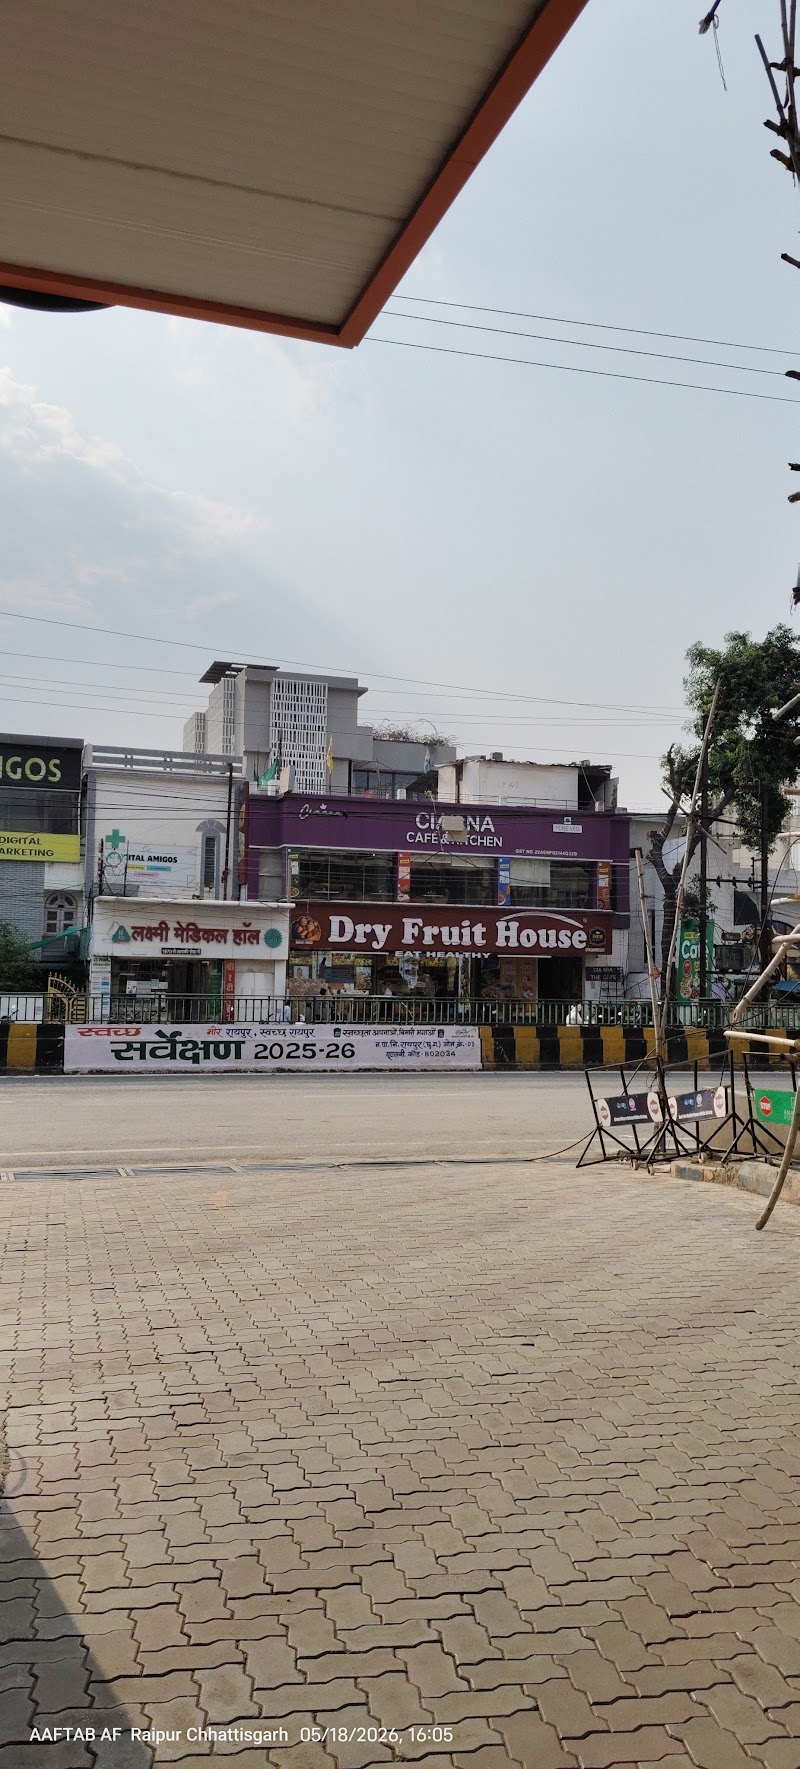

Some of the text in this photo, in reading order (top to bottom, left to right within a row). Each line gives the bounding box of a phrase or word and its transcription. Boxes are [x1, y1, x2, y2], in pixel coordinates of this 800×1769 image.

[0, 836, 42, 846] DIGITAL
[0, 847, 54, 857] ARKETING
[147, 855, 178, 863] AMIGOS
[131, 921, 261, 946] लक्ष्मी मेडिकल हॉल
[328, 915, 587, 949] Dry Fruit House
[426, 951, 491, 959] HEALTHY
[77, 1027, 142, 1037] स्वच्छ
[206, 1026, 223, 1038] मोर
[260, 1028, 287, 1037] स्वच्छ
[289, 1028, 316, 1038] रायपुर
[342, 1028, 372, 1038] स्वच्छता
[110, 1029, 356, 1064] सर्वेक्षण 2025-26
[760, 1102, 771, 1110] STOP
